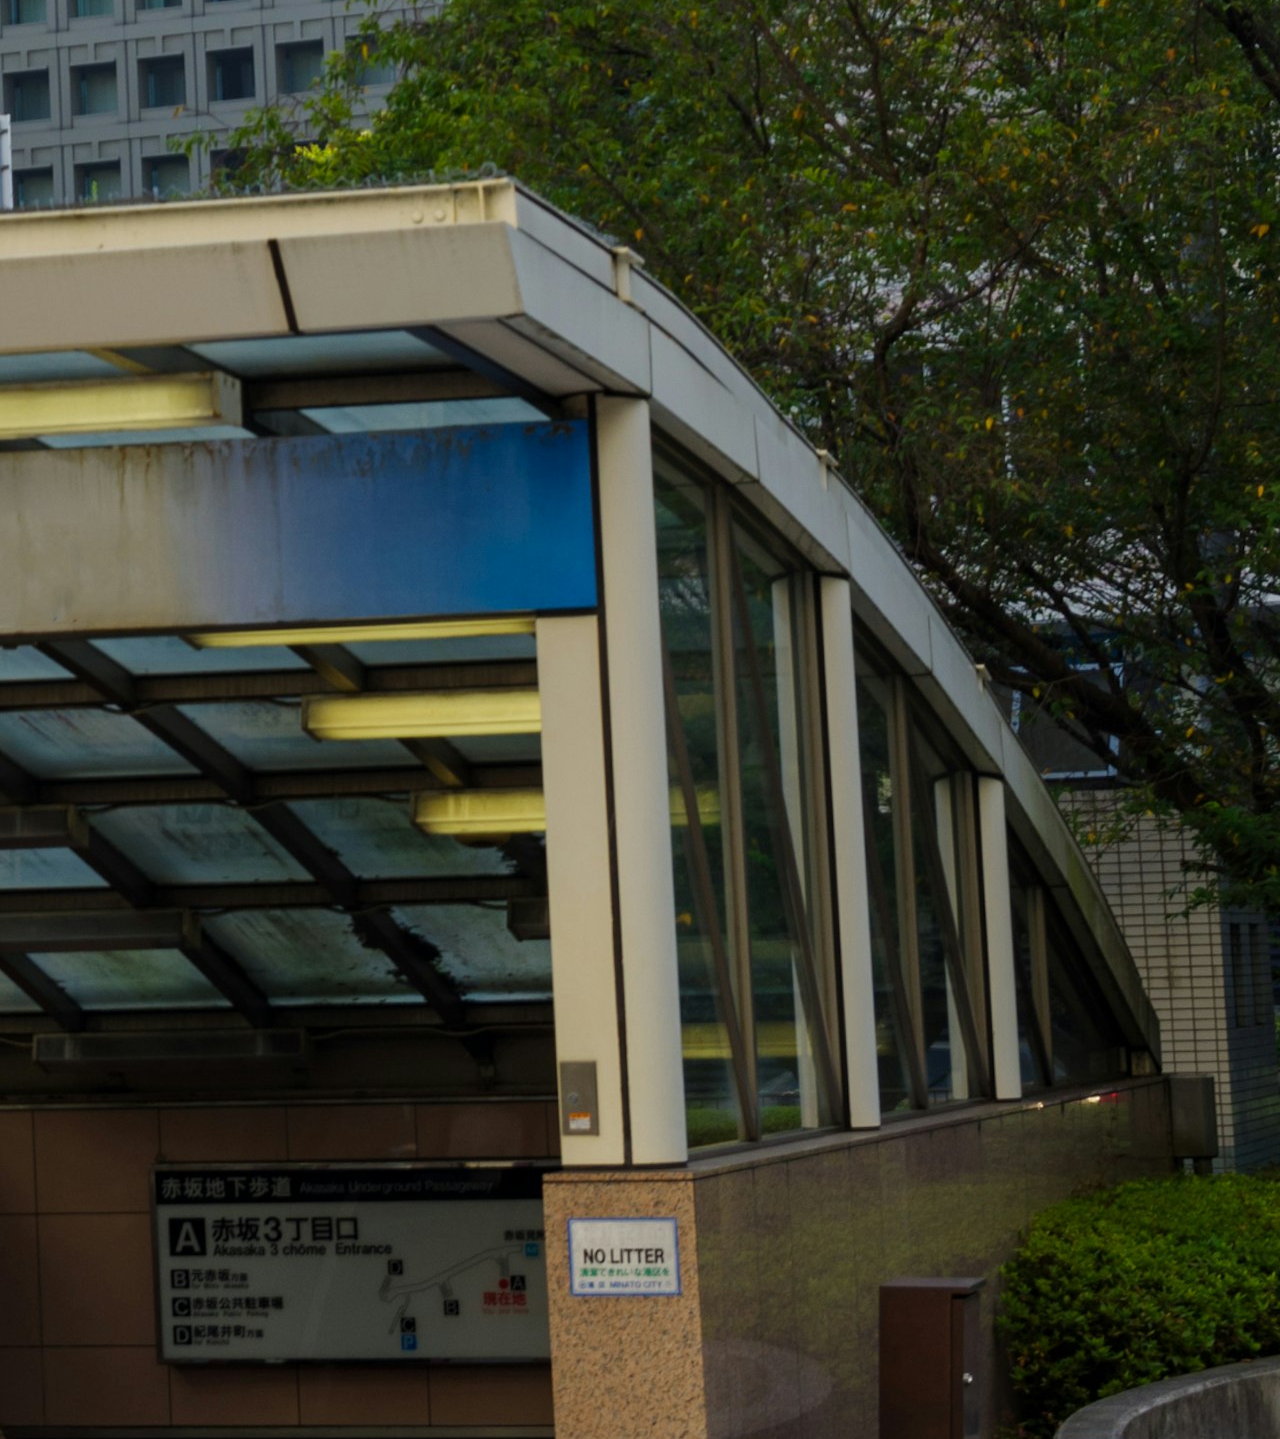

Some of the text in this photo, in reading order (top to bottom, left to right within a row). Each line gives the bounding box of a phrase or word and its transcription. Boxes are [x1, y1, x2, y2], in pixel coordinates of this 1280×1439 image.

[161, 1176, 293, 1199] 赤坂地下歩道
[174, 1221, 202, 1254] A
[212, 1217, 358, 1241] 赤坂3丁目口
[213, 1244, 266, 1256] Akasaka
[270, 1244, 279, 1256] 3
[335, 1242, 393, 1255] Entrance
[583, 1248, 664, 1264] NO LITTER
[173, 1270, 188, 1288] B
[175, 1298, 189, 1316] C
[176, 1326, 190, 1344] D
